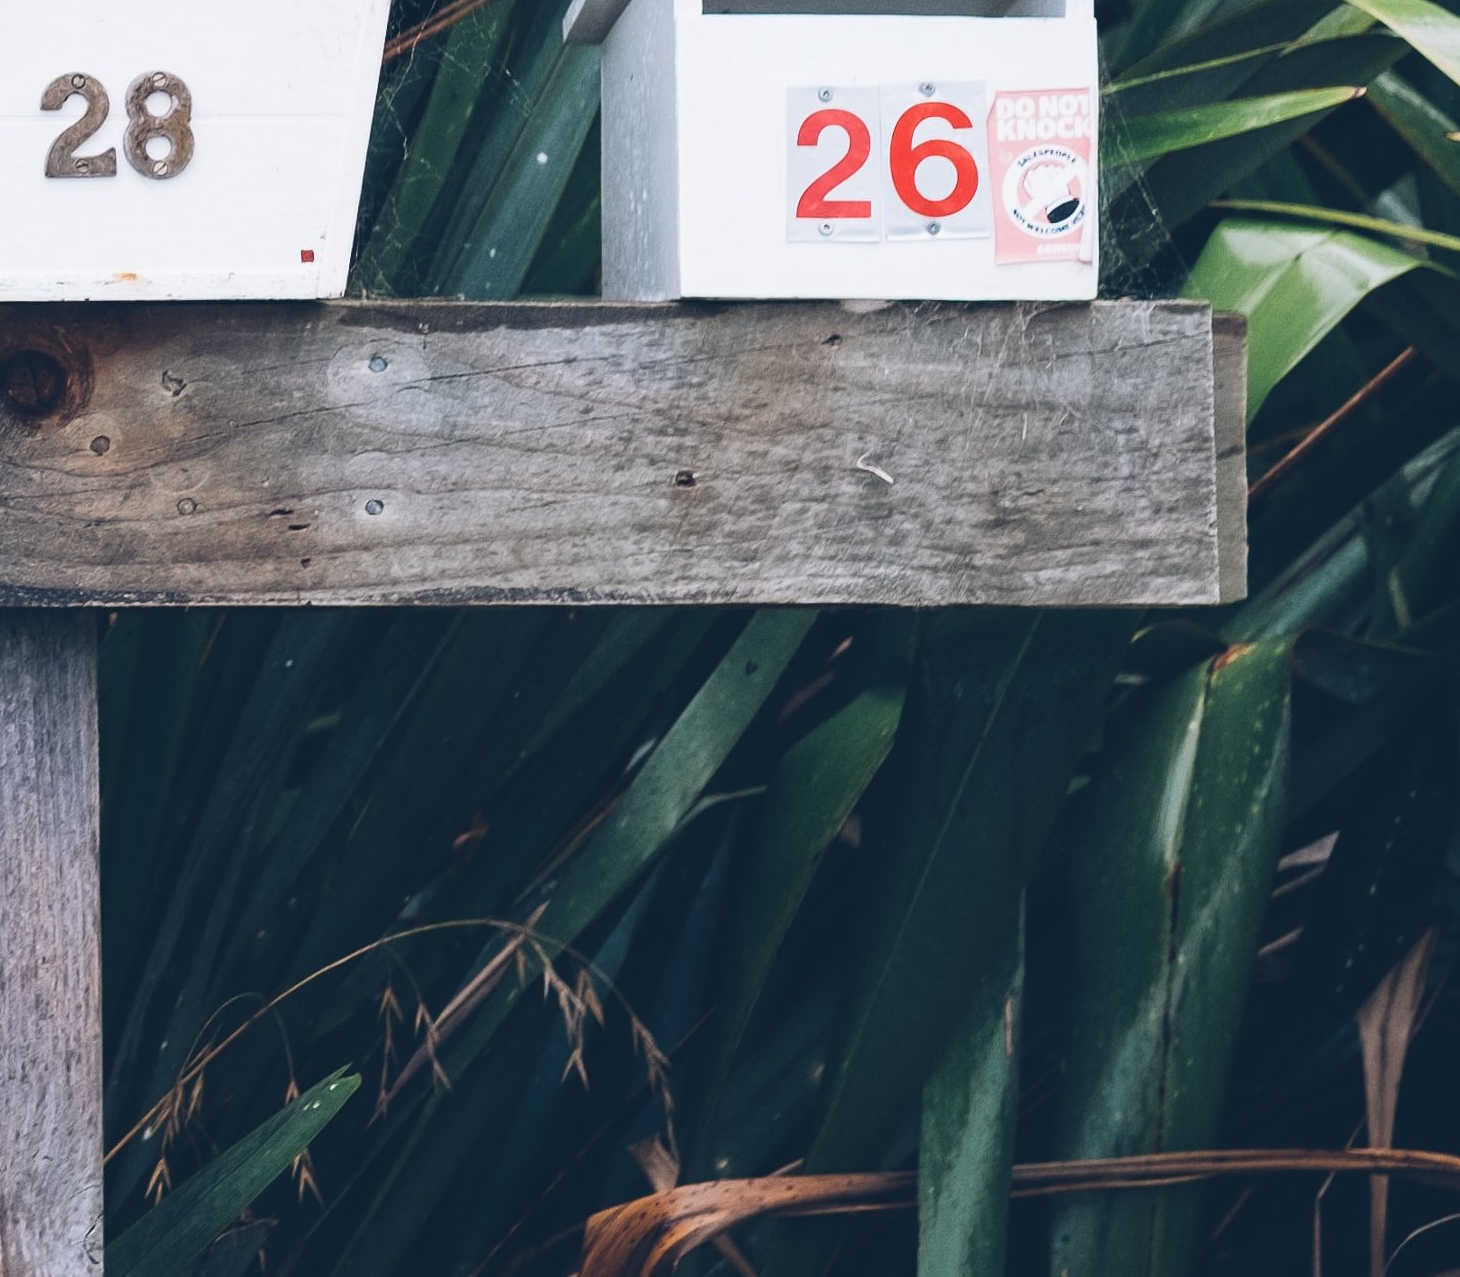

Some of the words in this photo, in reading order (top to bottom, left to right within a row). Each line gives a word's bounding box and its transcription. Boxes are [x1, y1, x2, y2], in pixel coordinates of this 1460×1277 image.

[39, 69, 196, 180] 28
[996, 96, 1035, 119] DO
[996, 116, 1091, 142] KNOCK
[795, 101, 979, 219] 26
